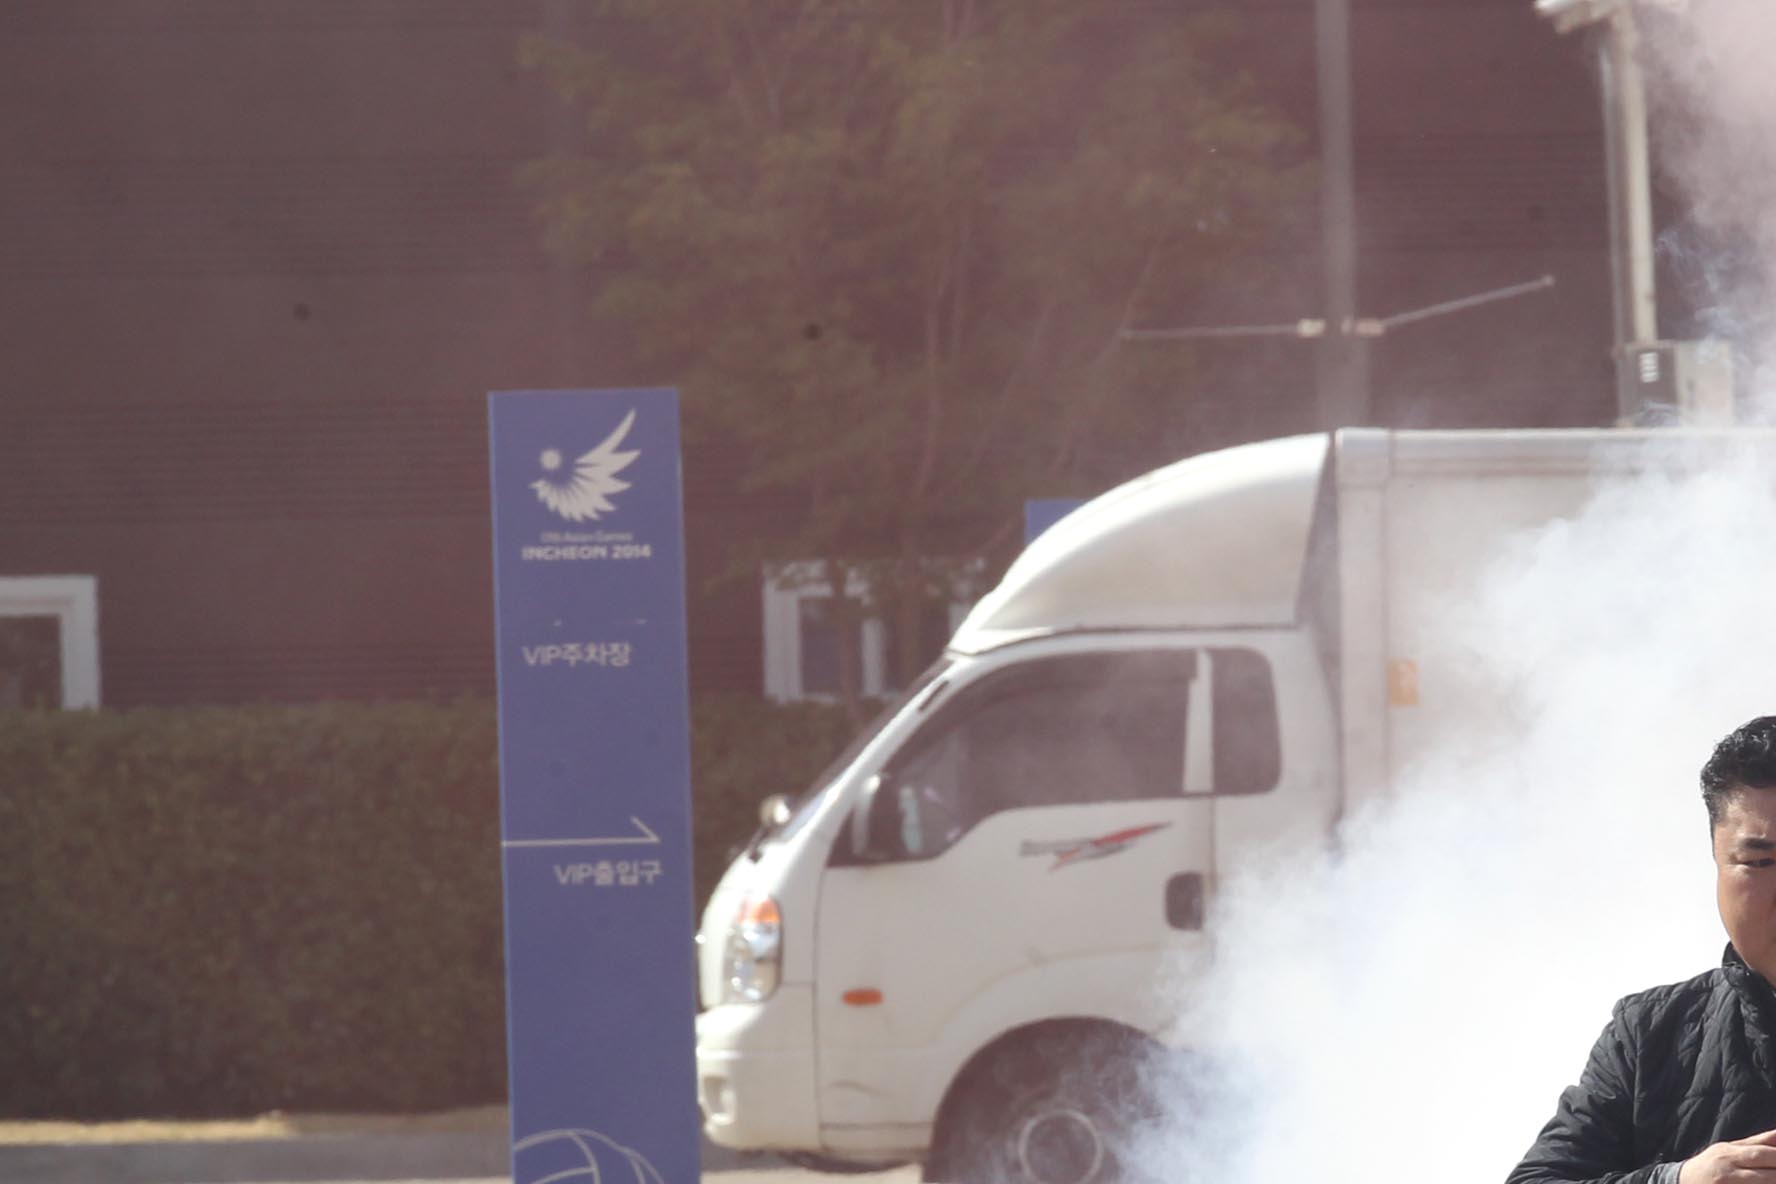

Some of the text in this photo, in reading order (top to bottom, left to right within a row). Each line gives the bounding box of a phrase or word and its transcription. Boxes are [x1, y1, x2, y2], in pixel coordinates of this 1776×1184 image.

[521, 543, 652, 561] INCHEON 2014
[521, 641, 631, 668] VIP주차장
[553, 860, 662, 886] VIP출입구
